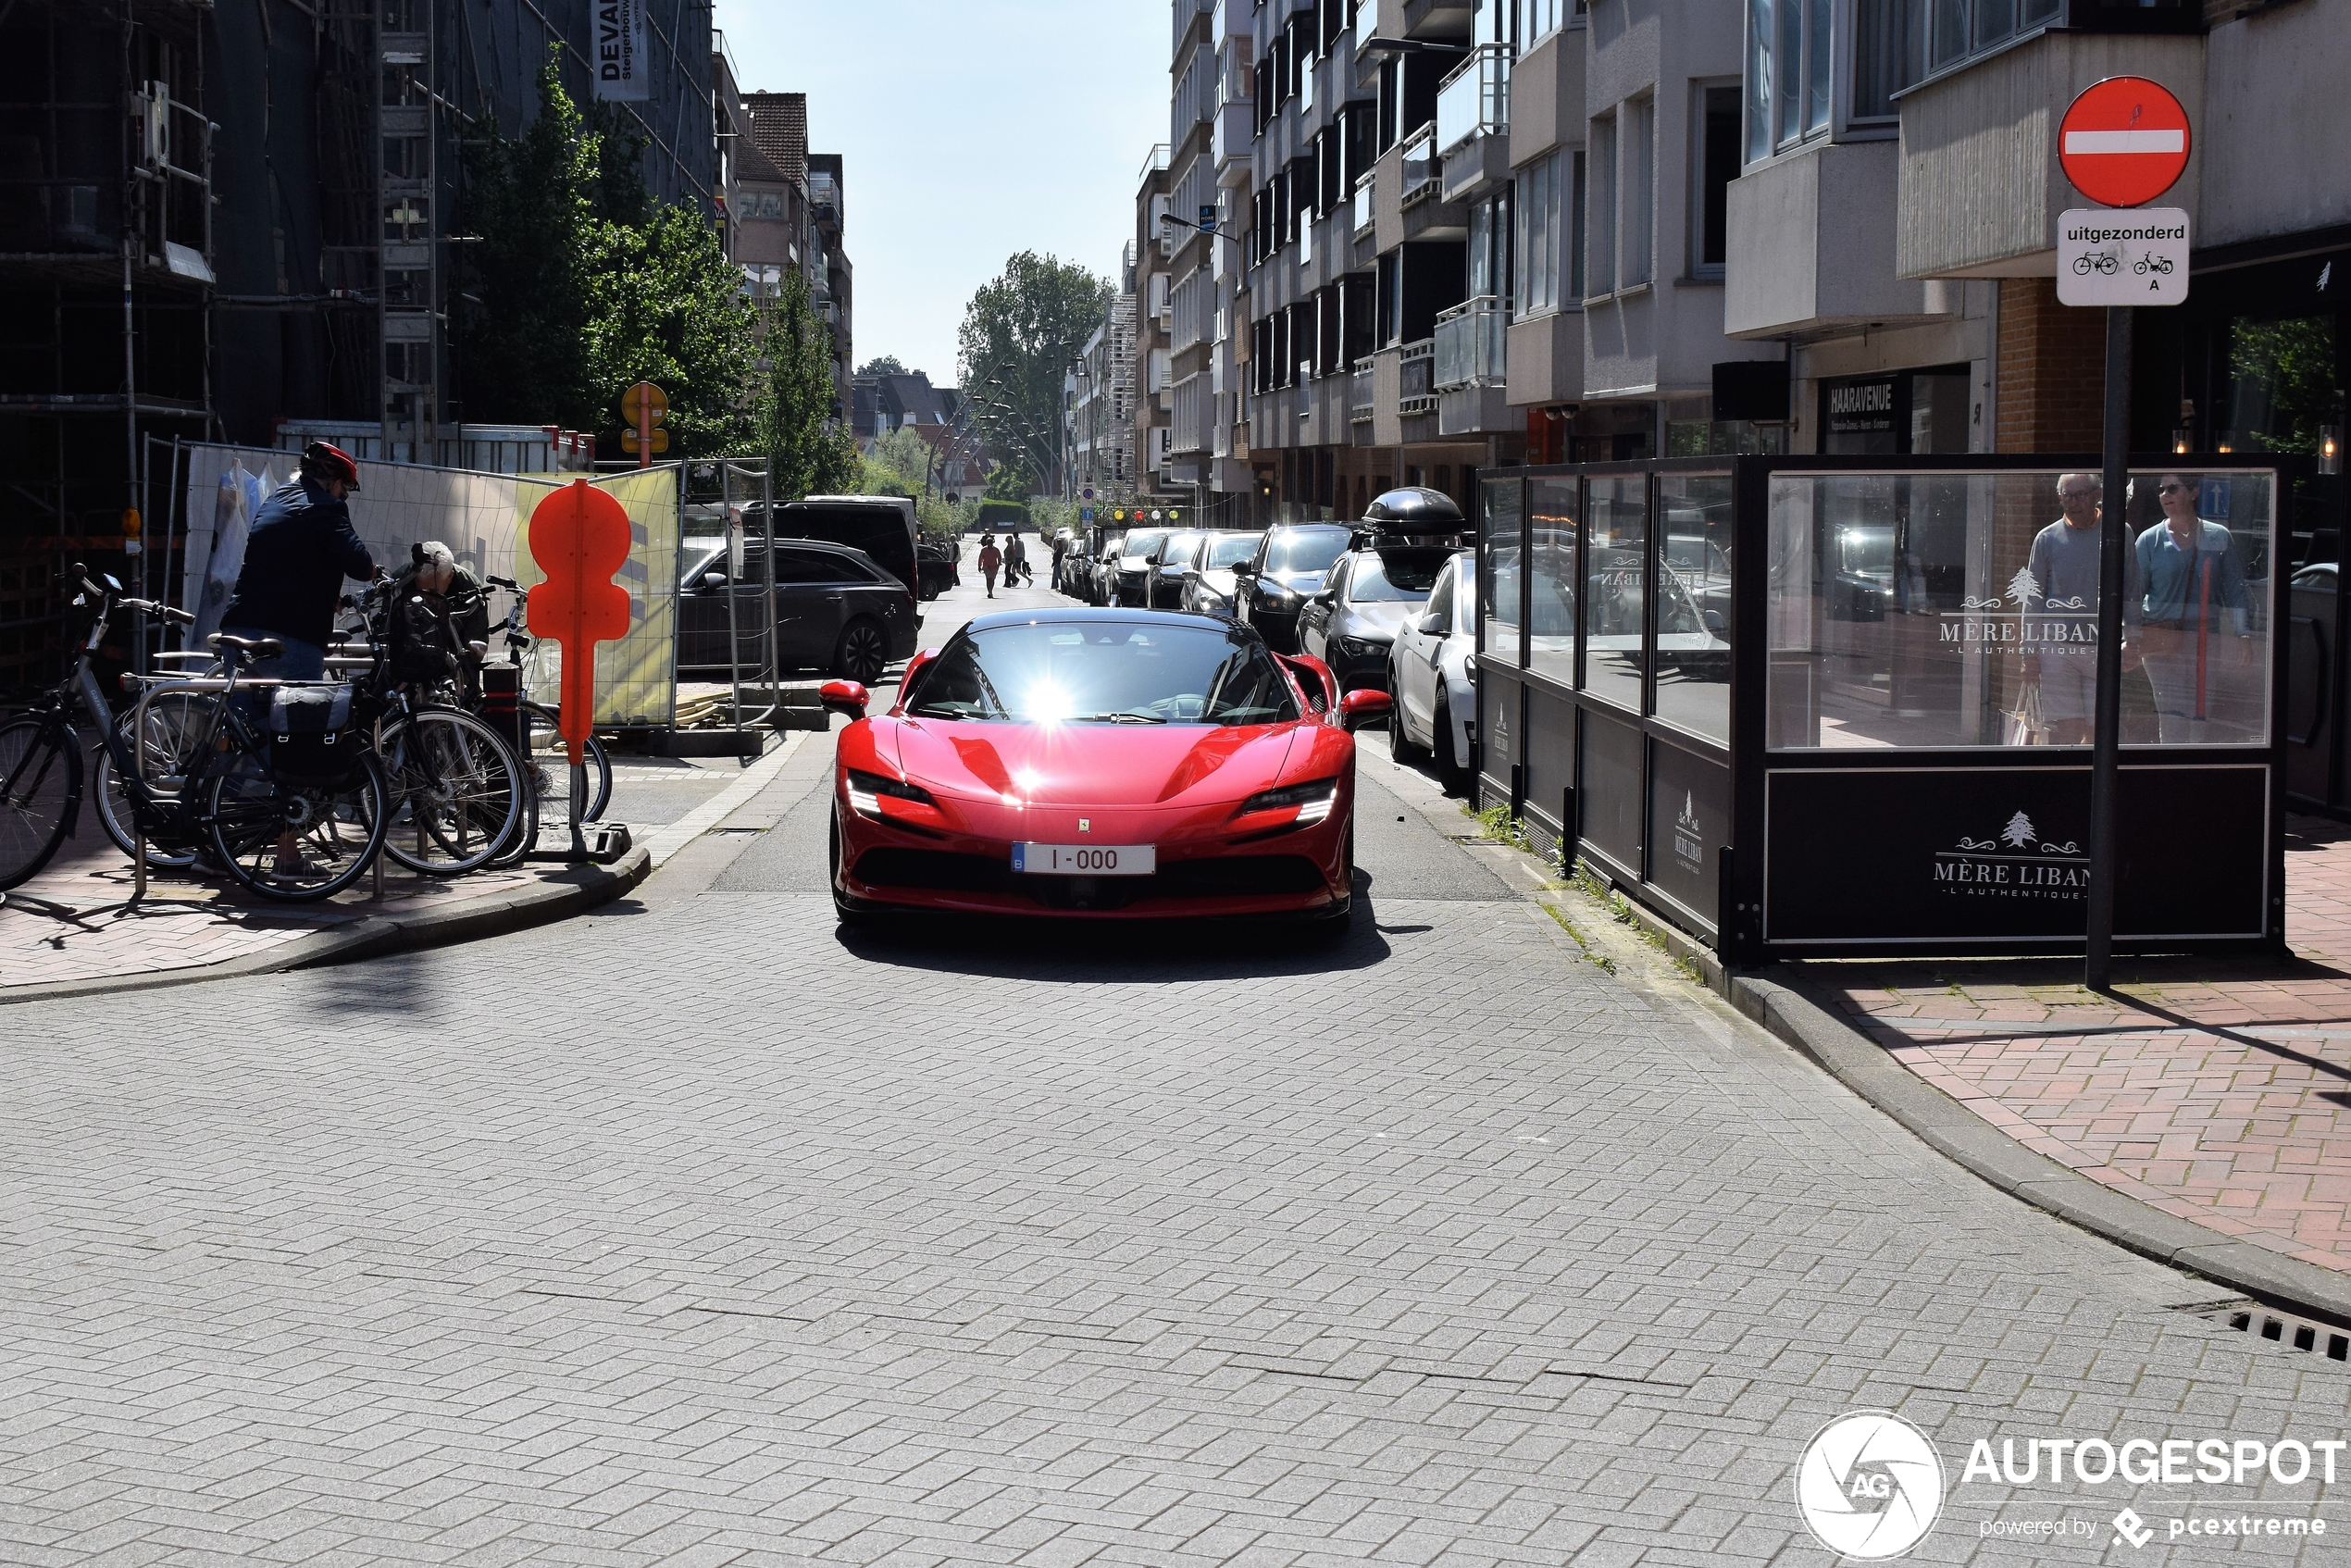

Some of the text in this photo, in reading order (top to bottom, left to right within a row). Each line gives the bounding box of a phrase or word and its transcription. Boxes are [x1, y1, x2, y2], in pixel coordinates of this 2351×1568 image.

[600, 0, 620, 81] DEVA
[2068, 225, 2184, 243] uitgezonderd
[2149, 280, 2159, 291] A
[1831, 383, 1892, 414] HAARAVENUE
[1938, 617, 2016, 642] MÈRE
[1014, 859, 1023, 869] B
[1933, 858, 2009, 884] MÈRE
